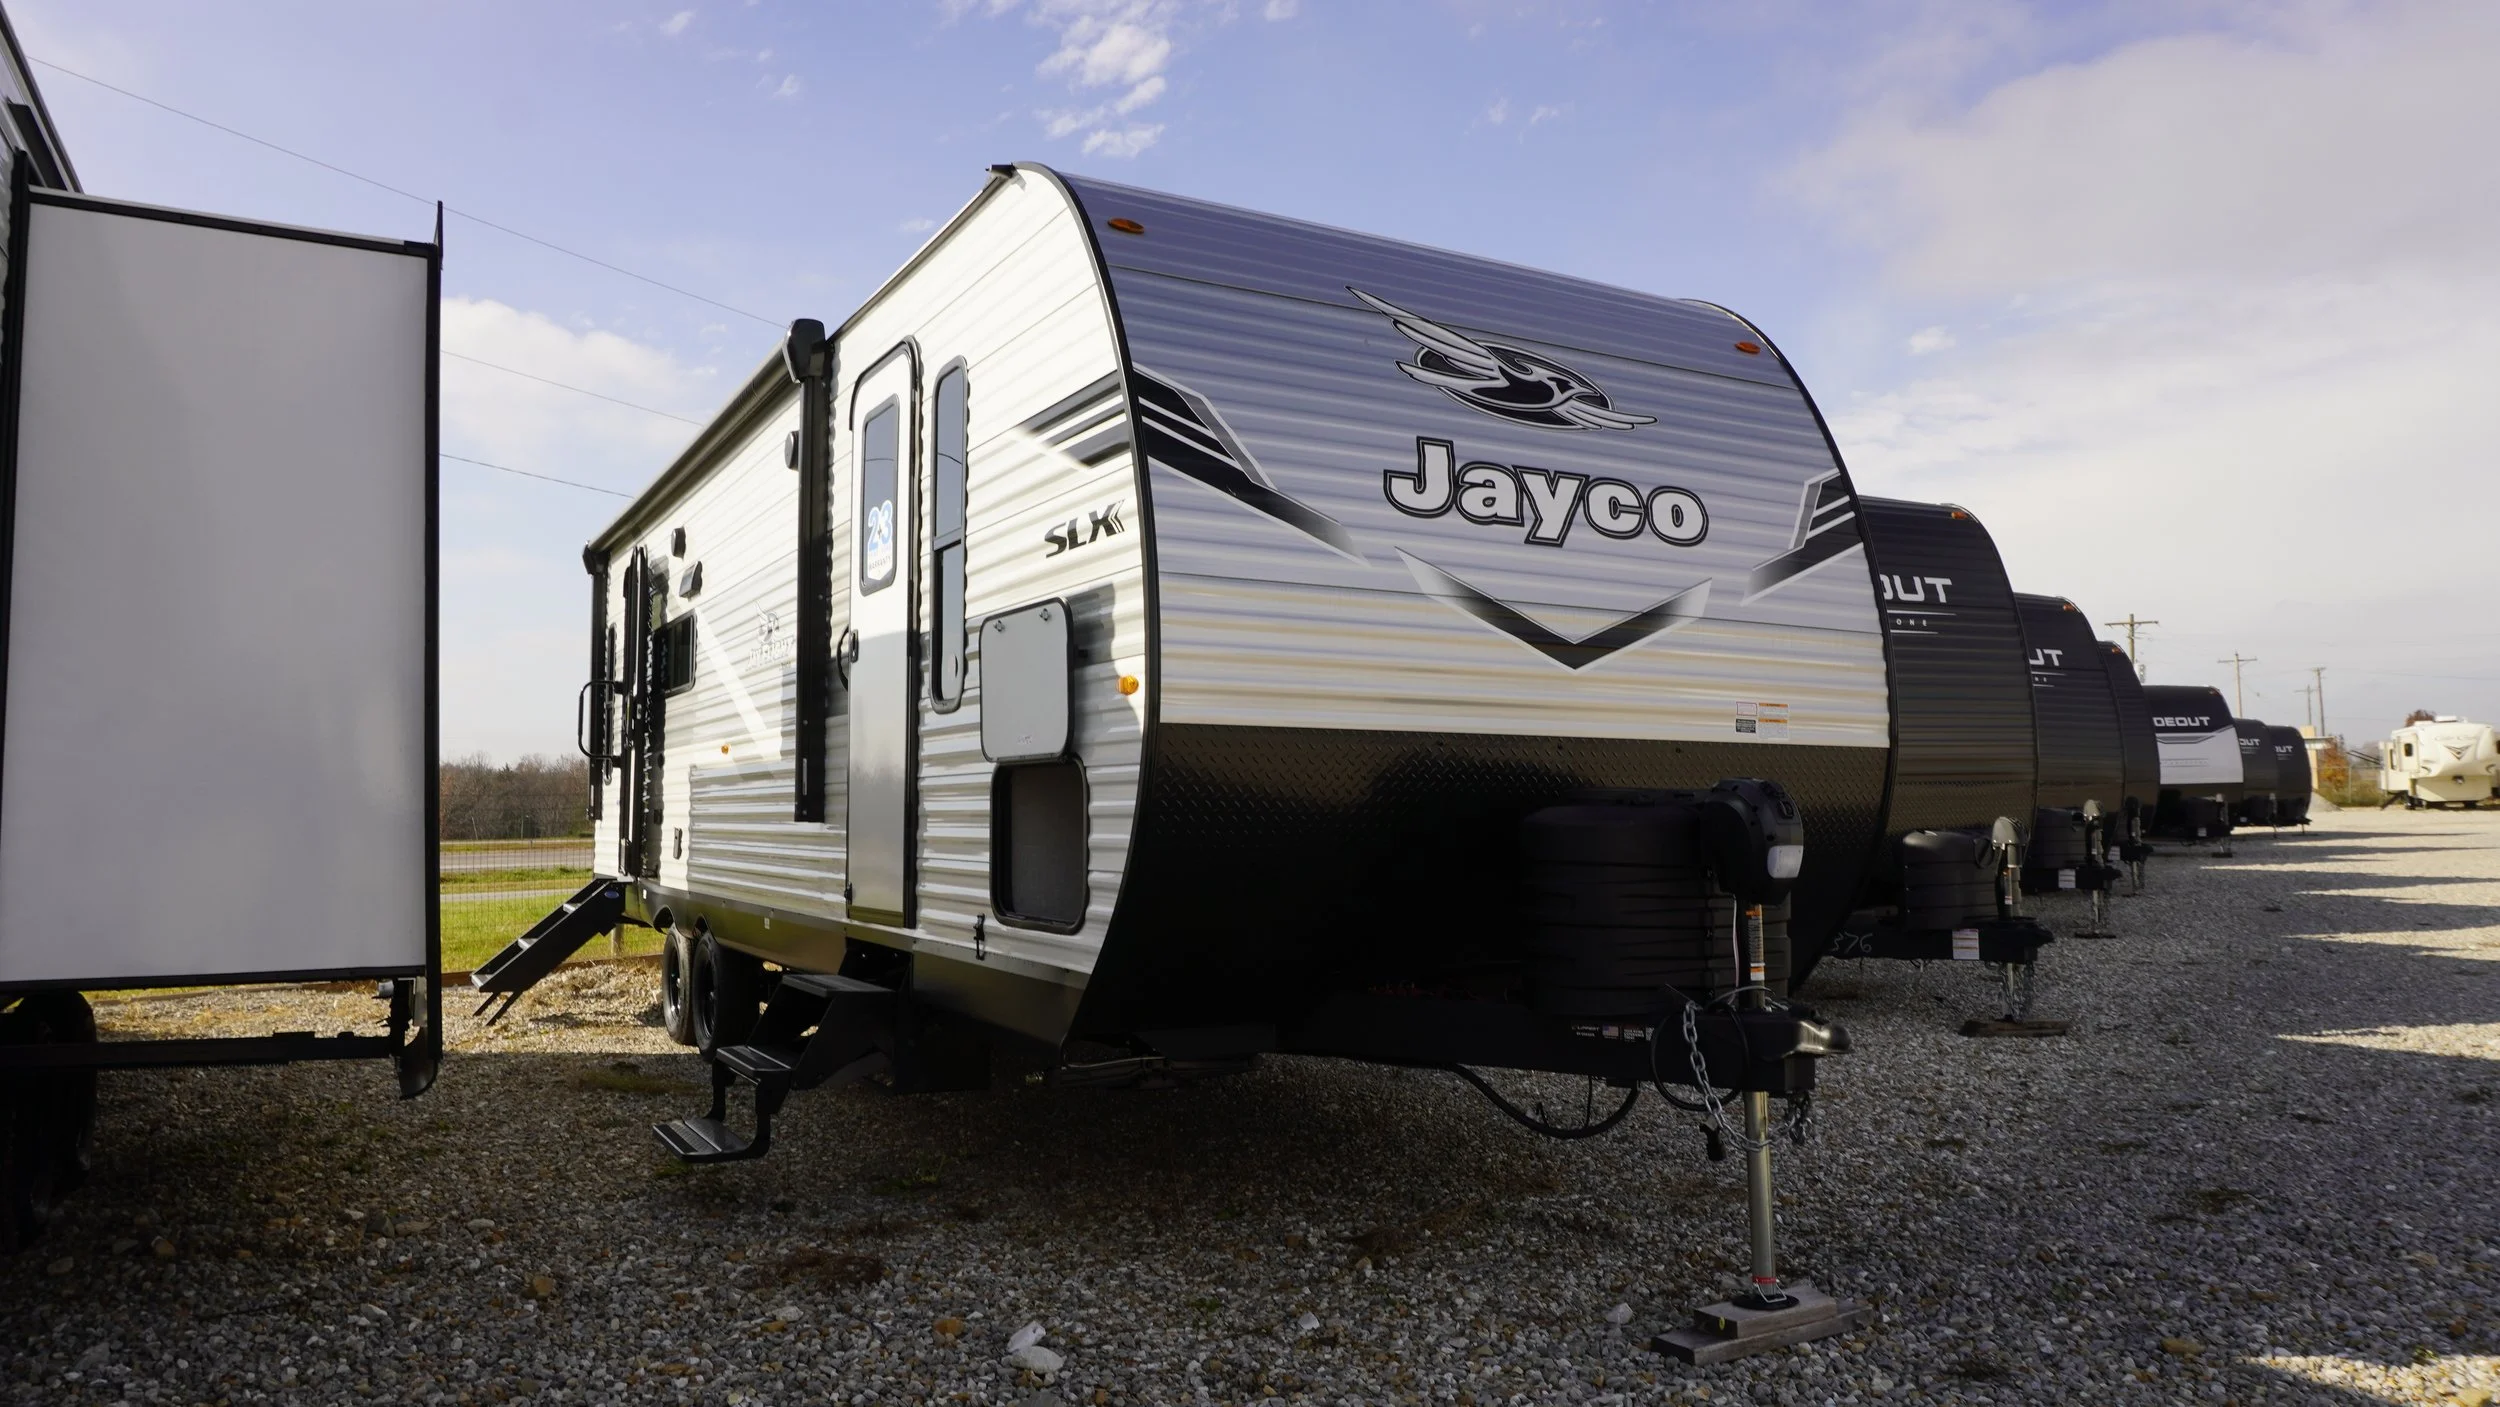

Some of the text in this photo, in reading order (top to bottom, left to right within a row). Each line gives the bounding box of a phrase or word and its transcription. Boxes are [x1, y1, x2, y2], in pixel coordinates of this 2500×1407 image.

[1383, 435, 1709, 548] Jayco
[1044, 499, 1125, 558] SLX
[1895, 618, 1928, 627] ONE
